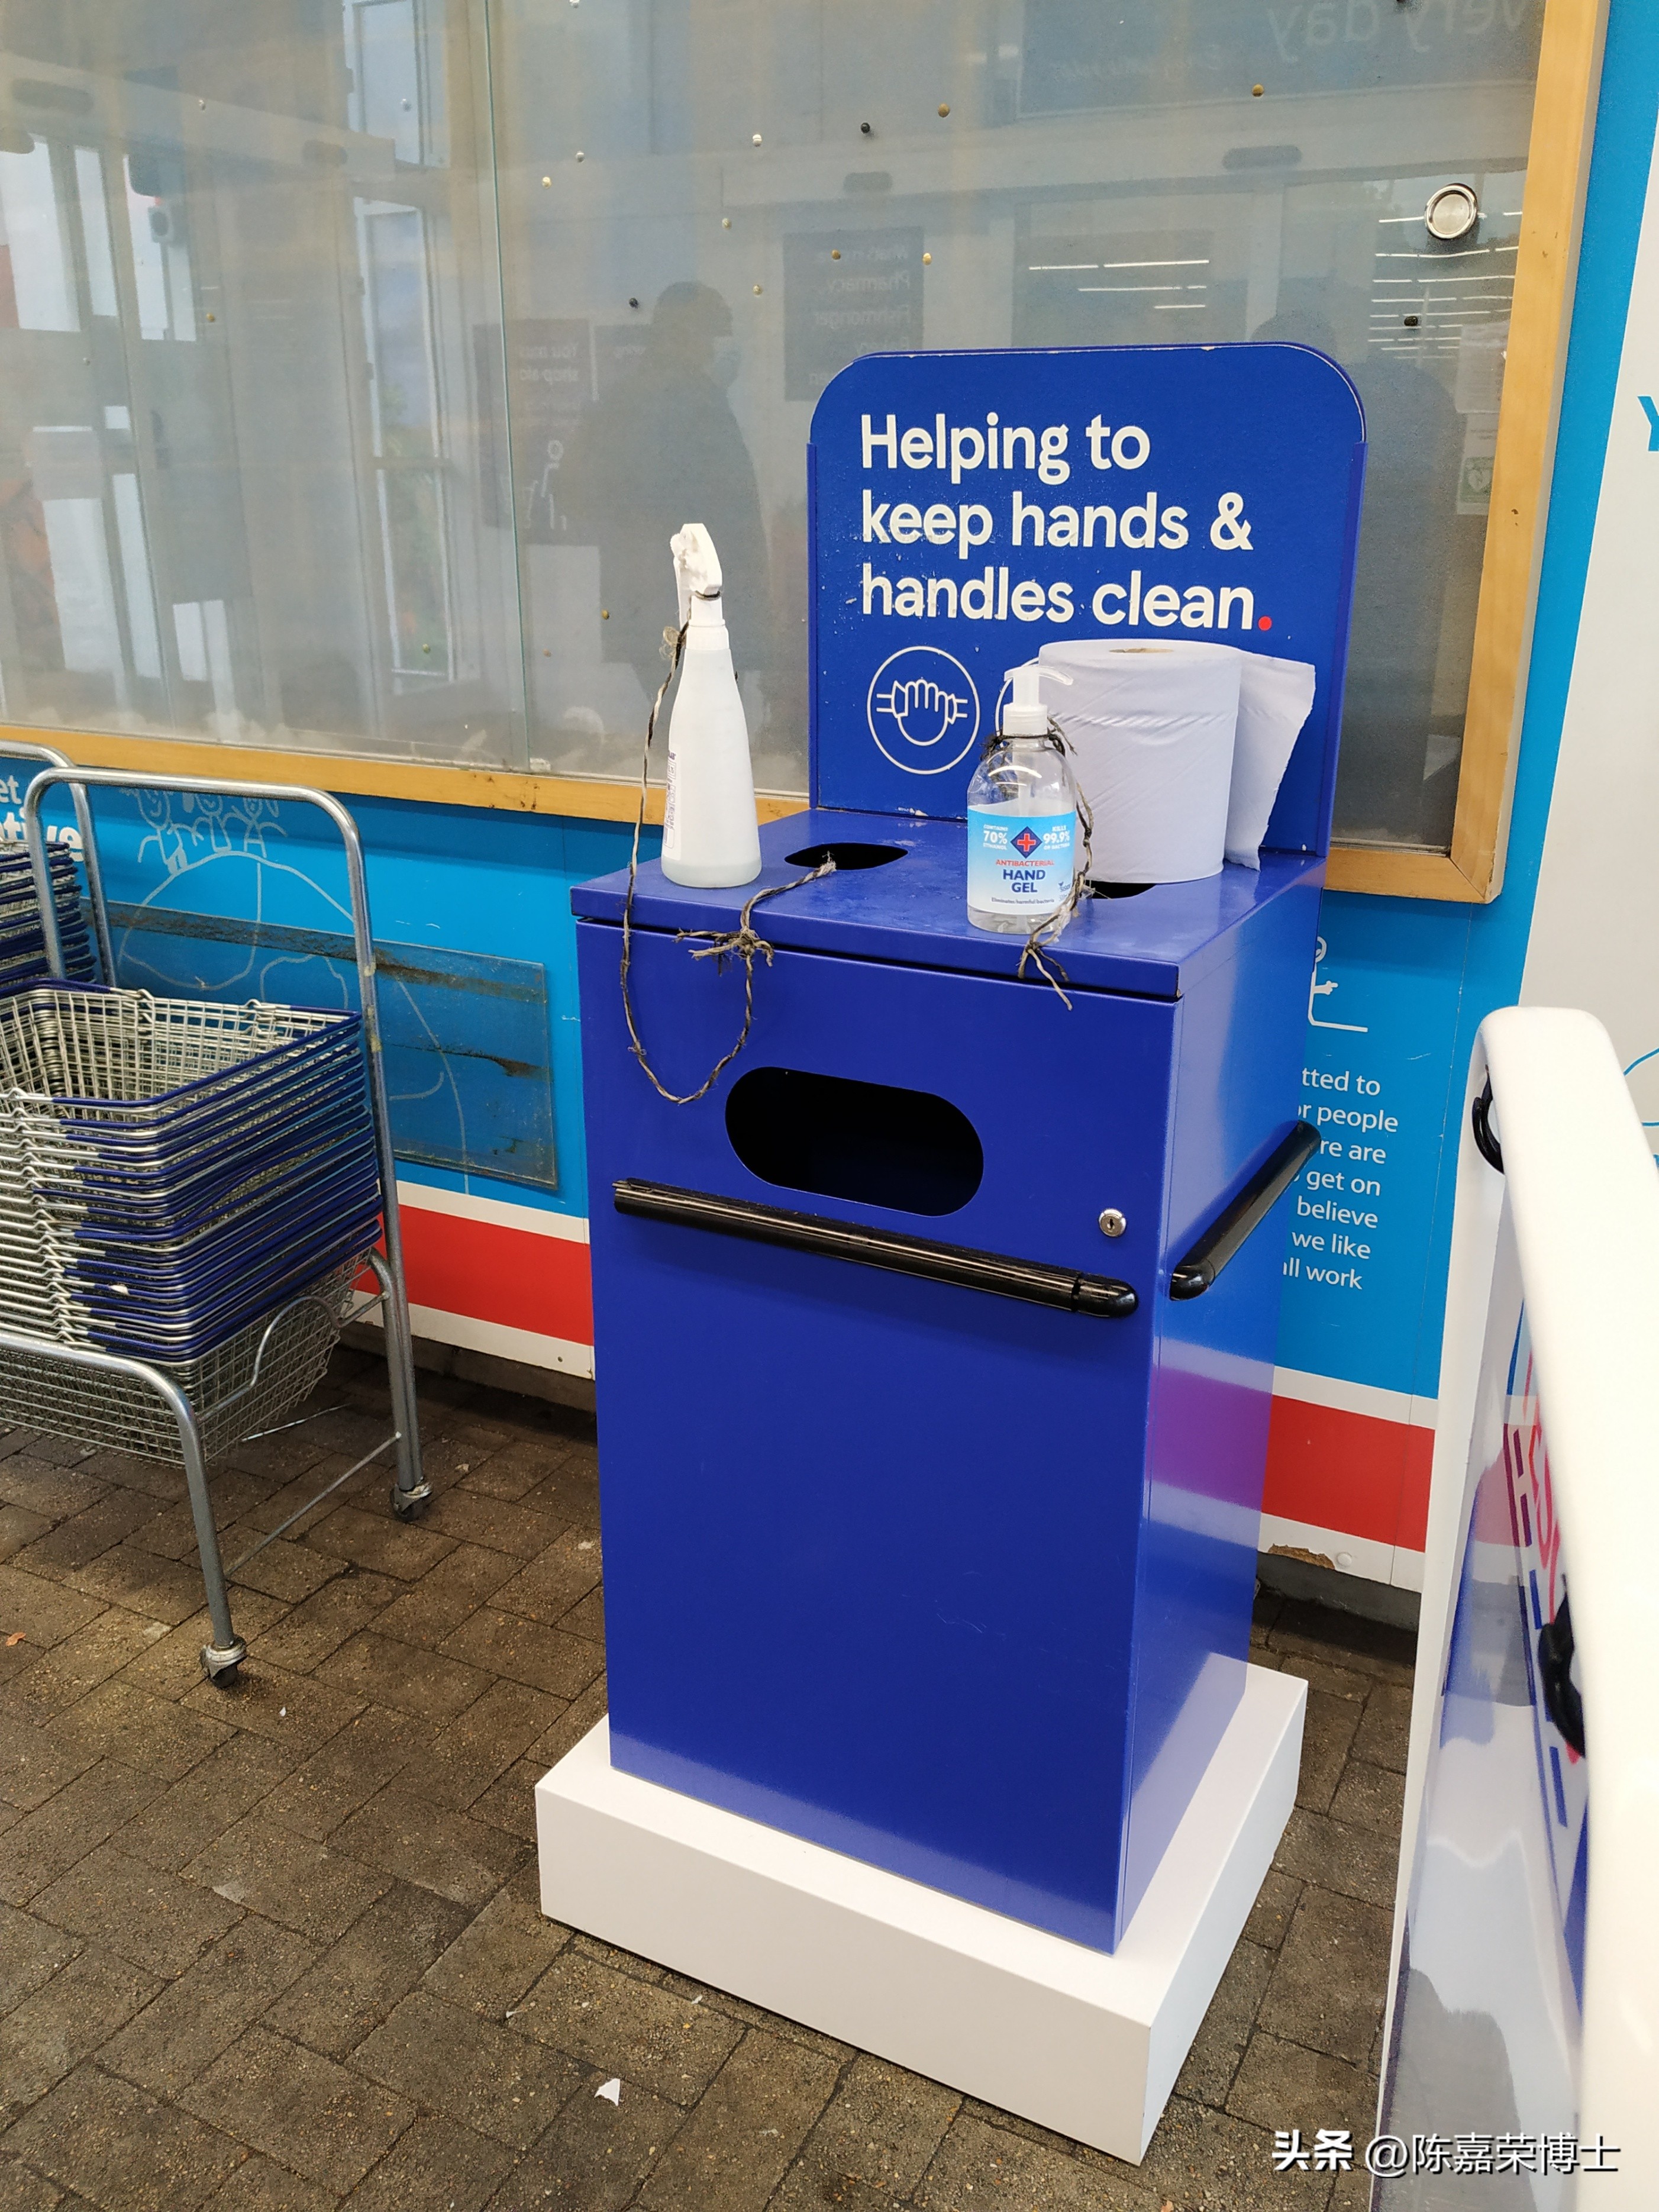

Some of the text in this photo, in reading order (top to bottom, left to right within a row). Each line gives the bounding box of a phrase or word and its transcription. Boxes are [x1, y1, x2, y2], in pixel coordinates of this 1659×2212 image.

[861, 412, 1150, 485] Helping to
[862, 489, 1254, 560] keep hands &
[862, 563, 1272, 631] handles clean.
[983, 830, 1008, 844] 70%
[1043, 830, 1070, 844] 99.9%
[995, 859, 1055, 867] ANTIBACTERIAL
[1002, 869, 1046, 881] HAND
[1011, 882, 1038, 893] GEL
[1356, 1076, 1381, 1096] to
[1297, 1104, 1398, 1133] r people
[1348, 1145, 1386, 1164] are
[1306, 1171, 1345, 1191] get
[1351, 1178, 1381, 1196] on
[1297, 1195, 1379, 1228] believe
[1292, 1232, 1371, 1259] we like
[1306, 1265, 1363, 1290] work
